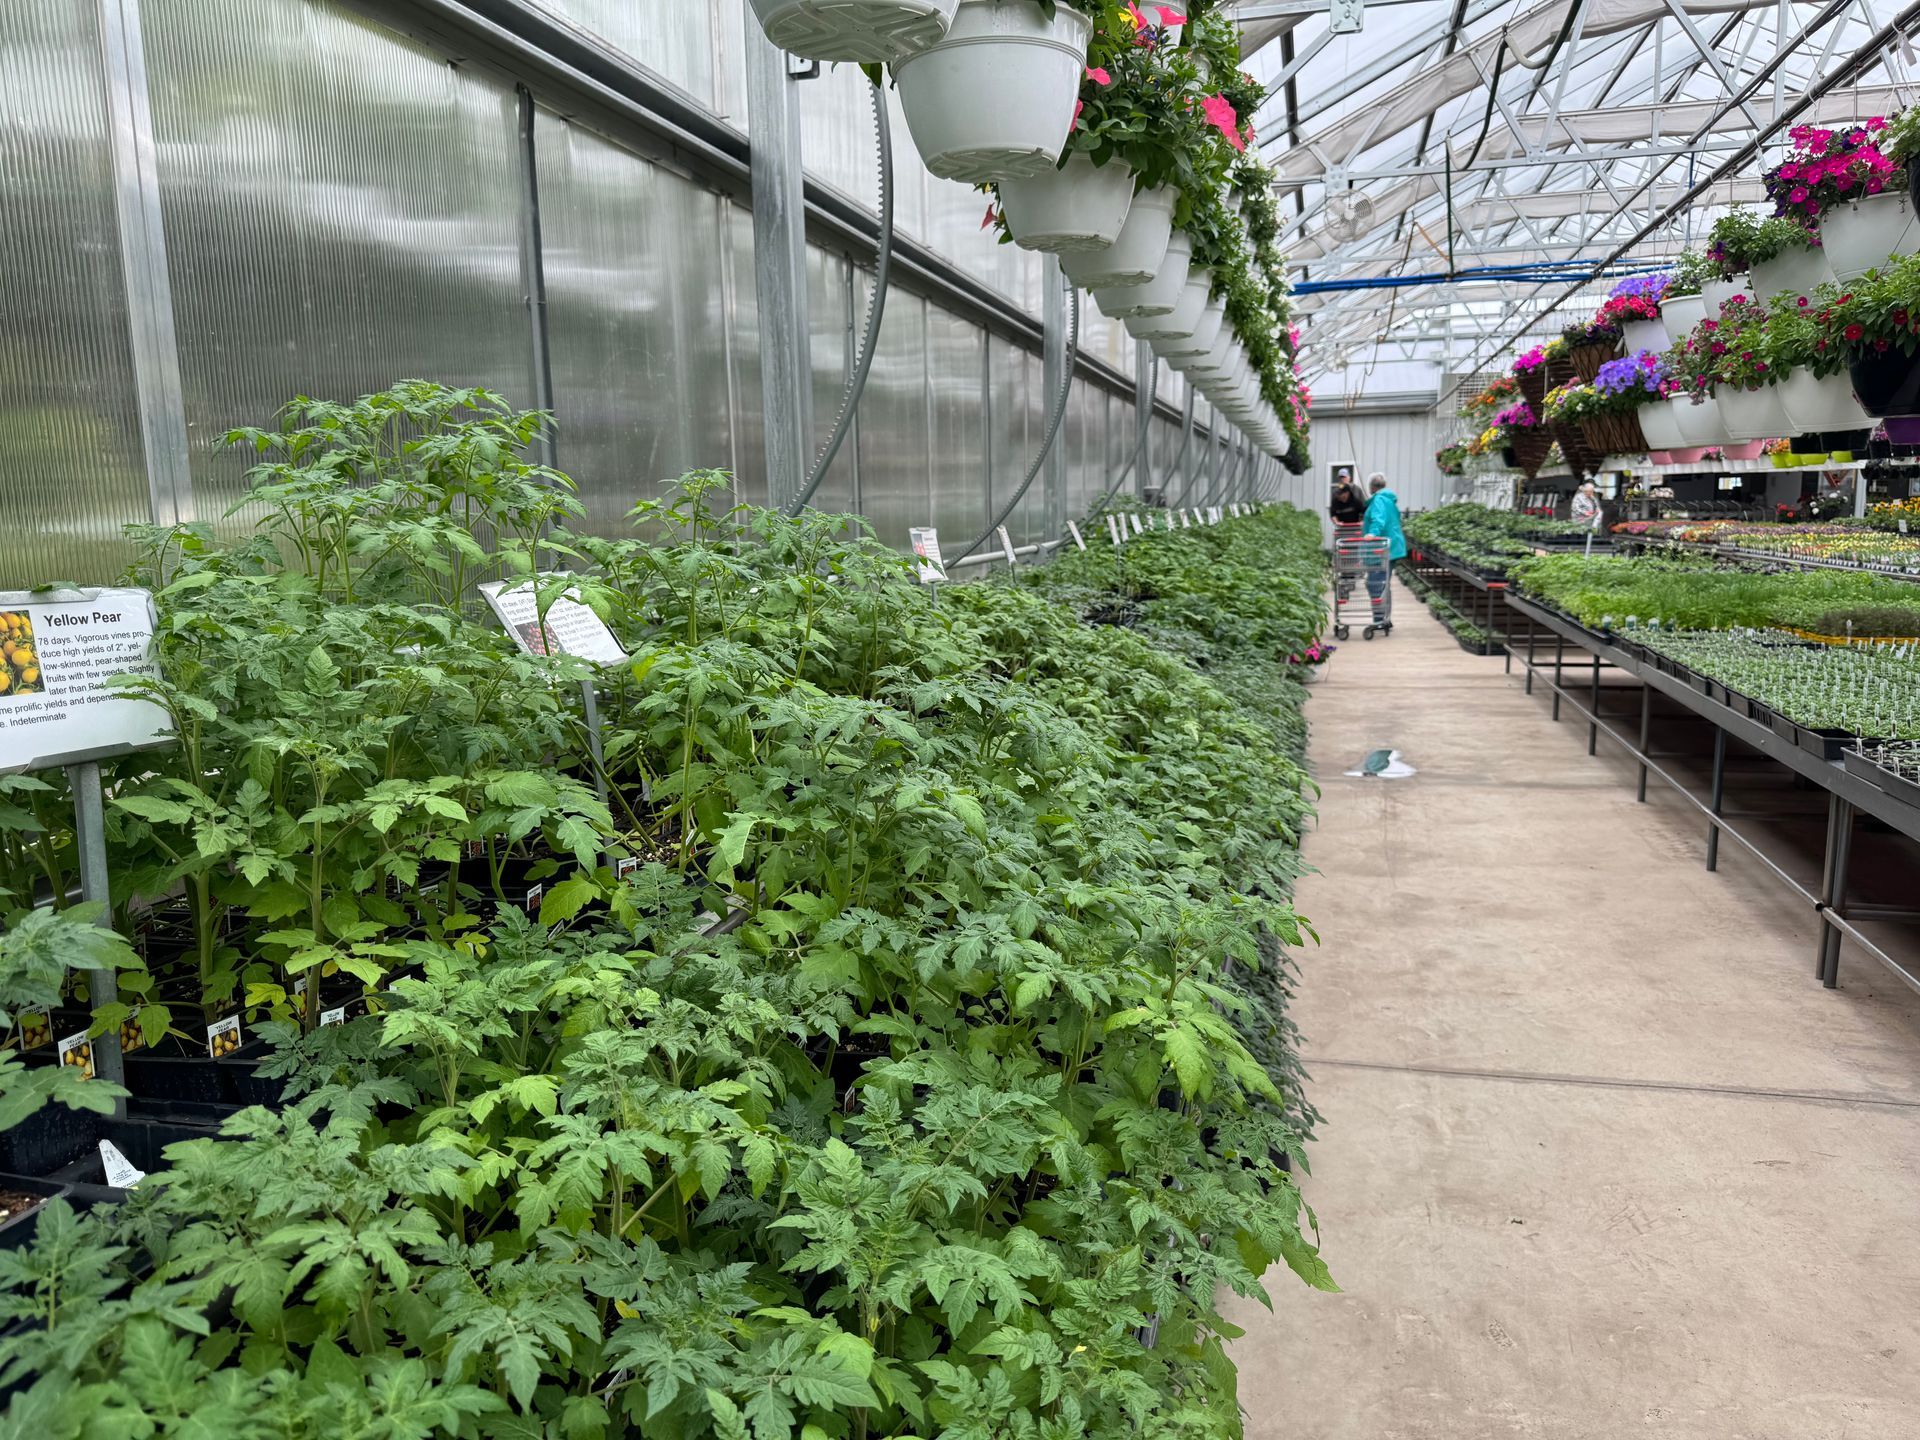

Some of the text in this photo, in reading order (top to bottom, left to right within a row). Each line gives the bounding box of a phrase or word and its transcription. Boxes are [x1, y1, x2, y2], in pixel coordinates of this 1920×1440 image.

[44, 612, 121, 627] Yellow Pear
[51, 636, 73, 645] days.
[75, 634, 109, 643] Vigorous
[132, 631, 146, 640] pro-
[41, 650, 61, 658] duce
[64, 648, 80, 657] high
[82, 646, 104, 656] yields
[128, 642, 141, 651] yel-
[96, 654, 142, 666] pear-shaped
[46, 674, 66, 682] fruits
[68, 672, 84, 680] with
[128, 665, 154, 674] Slightly
[49, 687, 66, 695] later
[69, 685, 86, 693] than
[0, 706, 12, 714] me
[15, 703, 42, 714] prolific
[44, 699, 67, 711] yields
[70, 696, 84, 705] and
[10, 713, 66, 727] Indeterminate
[215, 1020, 232, 1029] YELLOW
[66, 1036, 84, 1044] YELLOW
